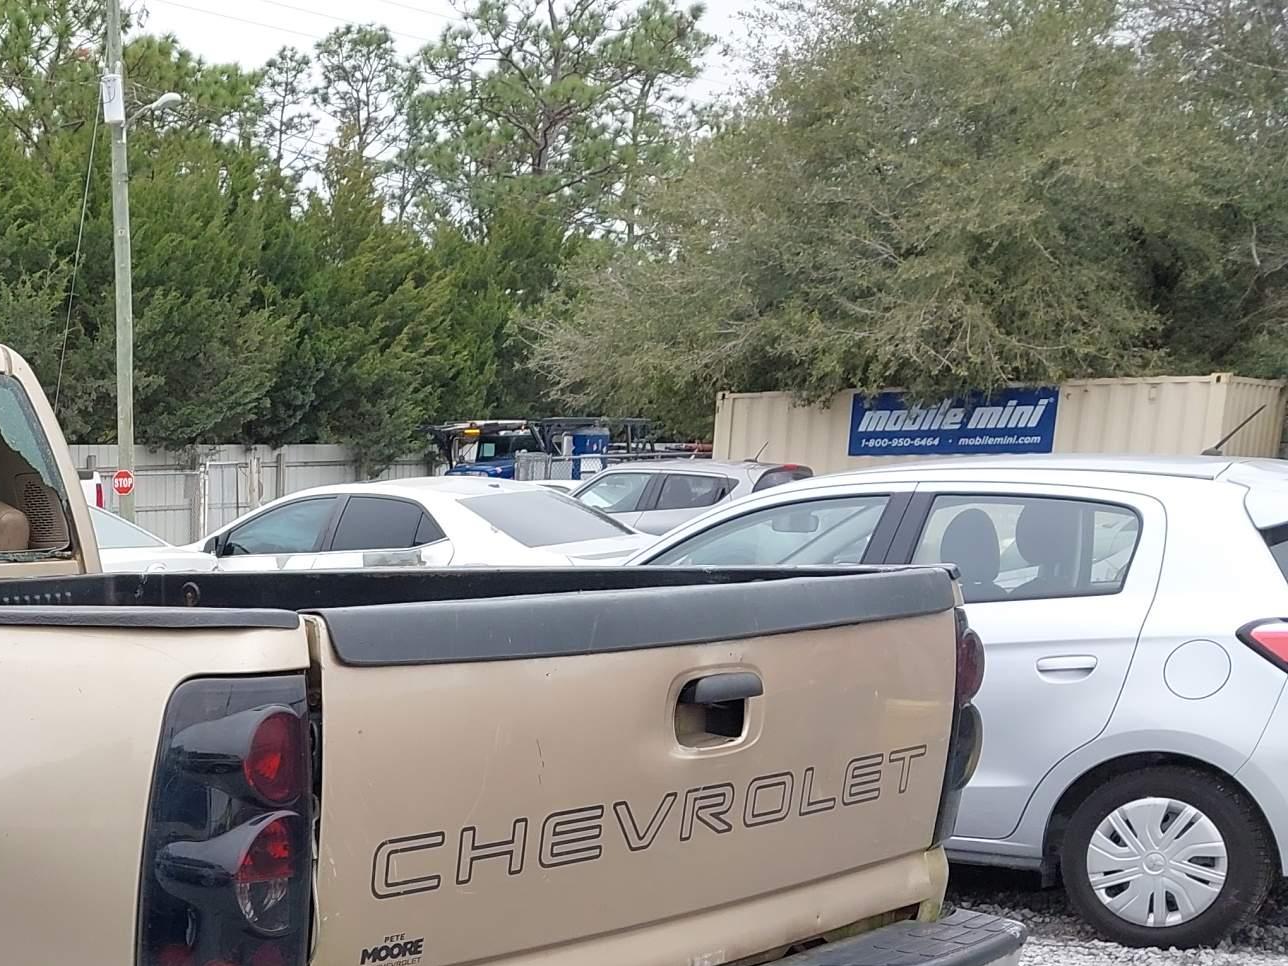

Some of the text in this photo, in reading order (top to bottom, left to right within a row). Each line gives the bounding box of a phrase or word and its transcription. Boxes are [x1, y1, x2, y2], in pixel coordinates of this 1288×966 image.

[858, 398, 1048, 432] mobile mini
[861, 434, 1041, 448] 1-800-950-6464 mobilemini.com
[114, 477, 133, 488] STOP
[370, 744, 928, 900] CHEVROLET
[384, 933, 405, 943] PETE
[360, 937, 424, 965] MOORE
